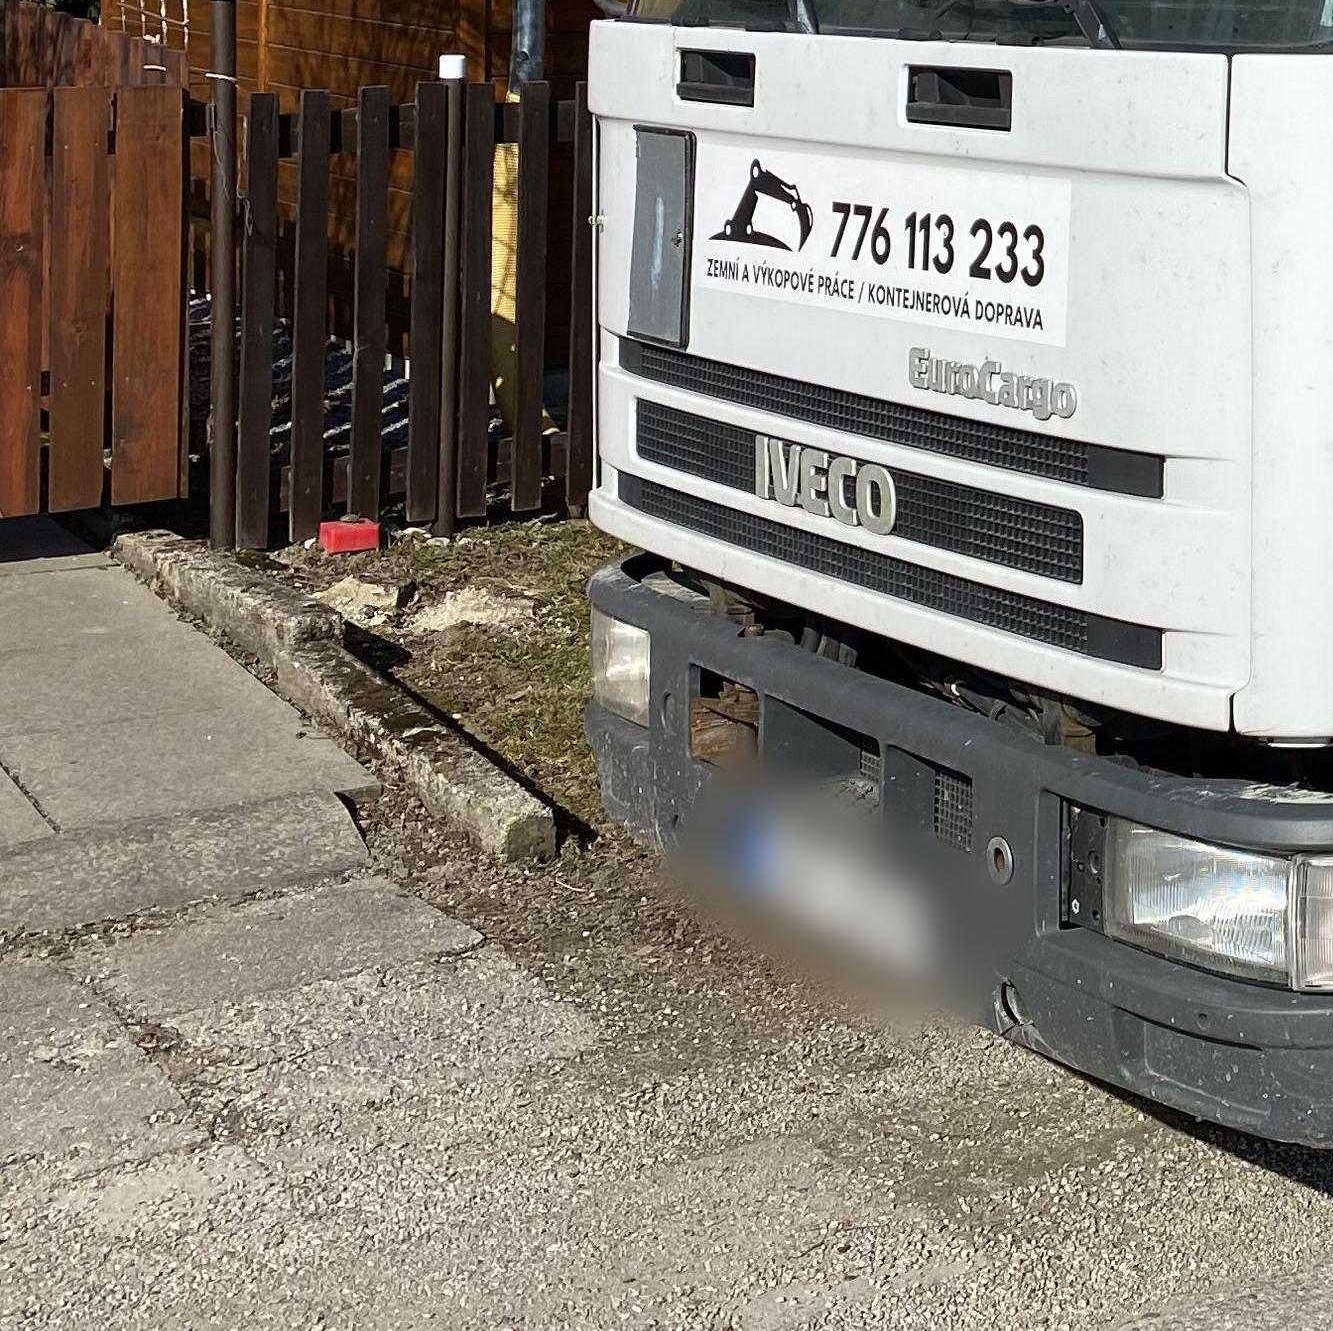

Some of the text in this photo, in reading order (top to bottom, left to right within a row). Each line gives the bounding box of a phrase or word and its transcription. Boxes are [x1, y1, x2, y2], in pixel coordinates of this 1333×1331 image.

[830, 201, 1045, 287] 776 113 233
[706, 256, 740, 281] ZEMNÍ
[742, 263, 750, 283] A
[753, 260, 814, 293] VÝKOPOVÉ
[818, 271, 854, 299] PRÁCE
[868, 283, 970, 319] KONTEJNEROVÁ
[975, 300, 1044, 330] DOPRAVA
[908, 347, 1078, 420] EuroCargo
[755, 434, 897, 535] IVECO
